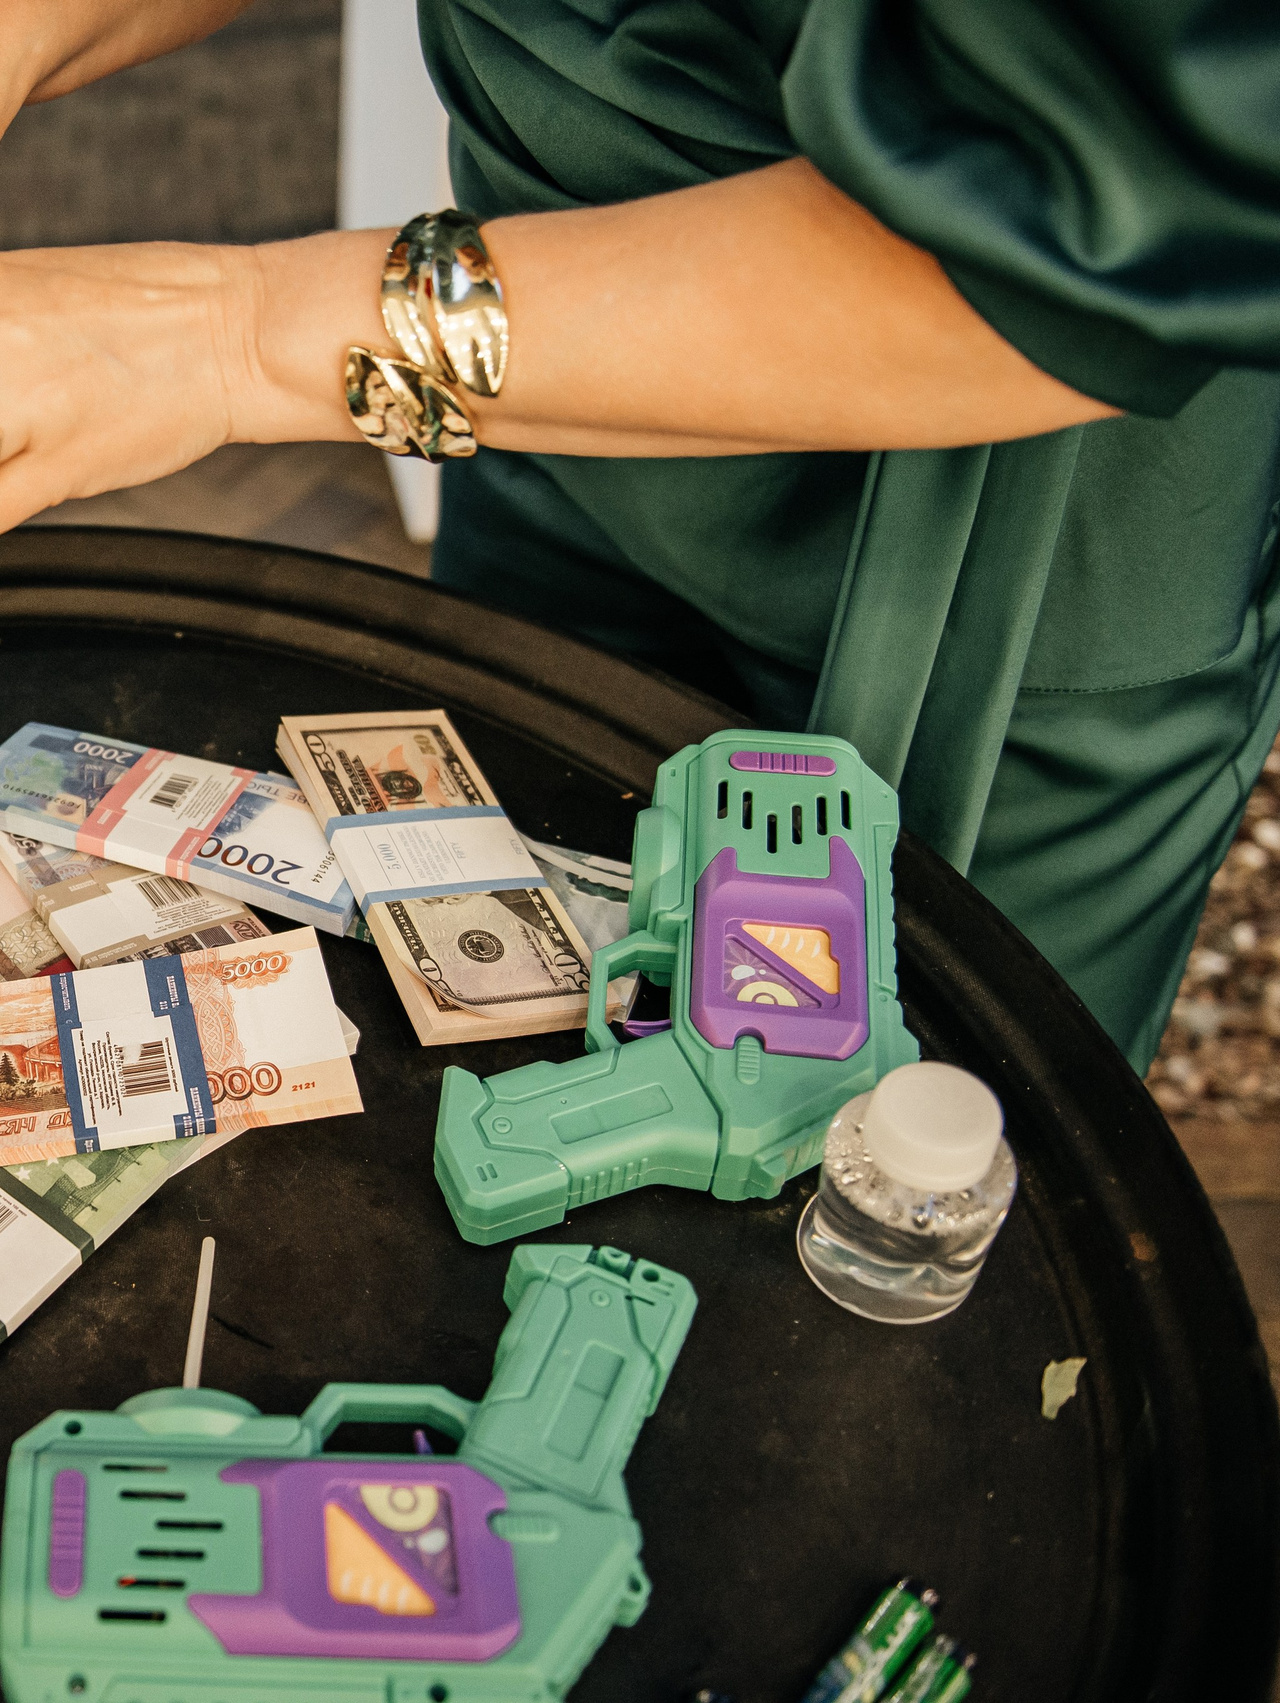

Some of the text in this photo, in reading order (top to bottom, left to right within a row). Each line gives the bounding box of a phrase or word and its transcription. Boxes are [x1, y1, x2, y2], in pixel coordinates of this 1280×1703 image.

[73, 740, 133, 763] 2000
[303, 730, 337, 776] 50
[197, 836, 305, 887] 2000
[390, 903, 420, 951] FEDERAL
[220, 953, 288, 979] 5000
[291, 1081, 317, 1093] 2121
